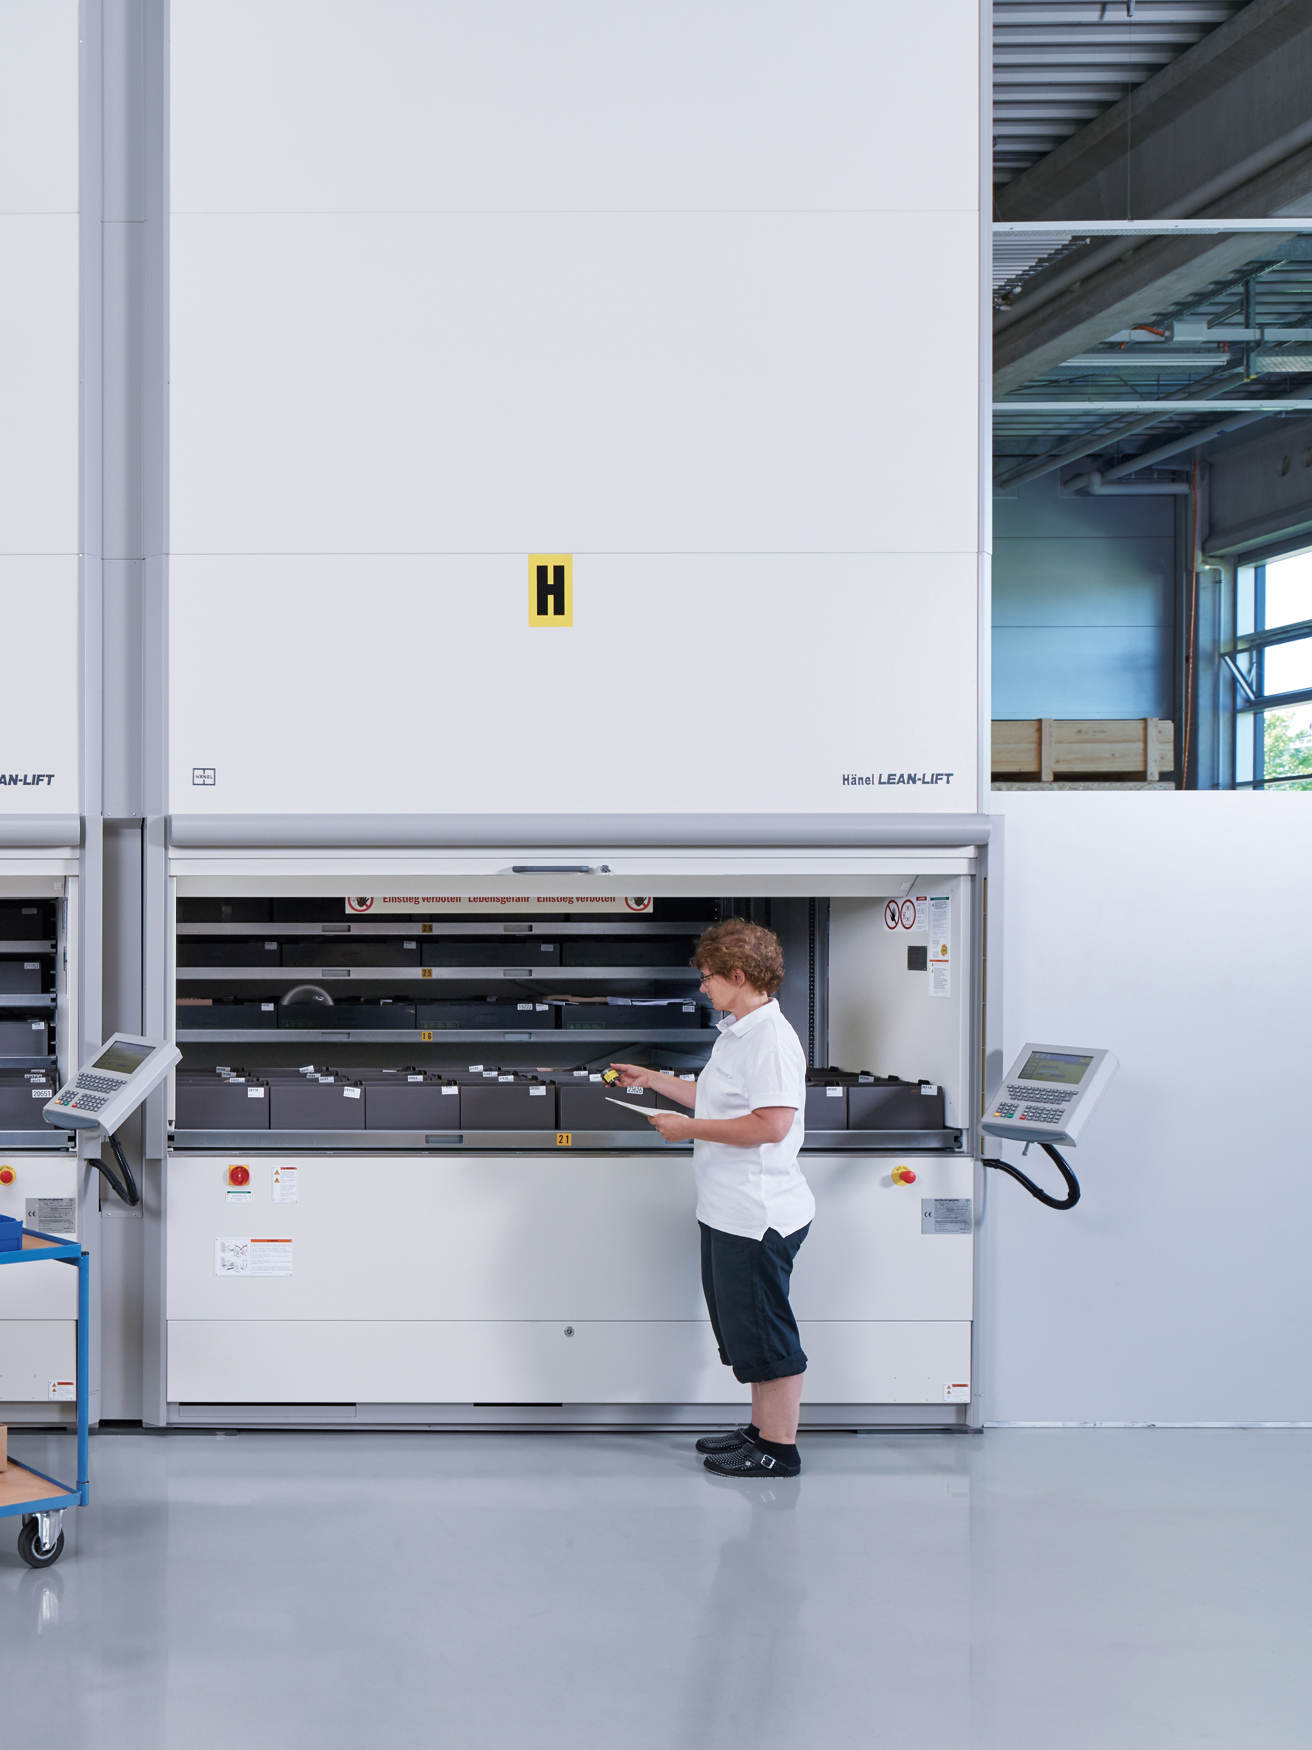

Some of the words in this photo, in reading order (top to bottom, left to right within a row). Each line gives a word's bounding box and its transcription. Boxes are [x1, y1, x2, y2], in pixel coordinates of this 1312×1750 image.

[536, 565, 565, 615] H
[842, 774, 875, 785] Hänel
[878, 773, 954, 785] LEAN-LIFT
[423, 1032, 432, 1040] 16
[558, 1134, 569, 1144] 21
